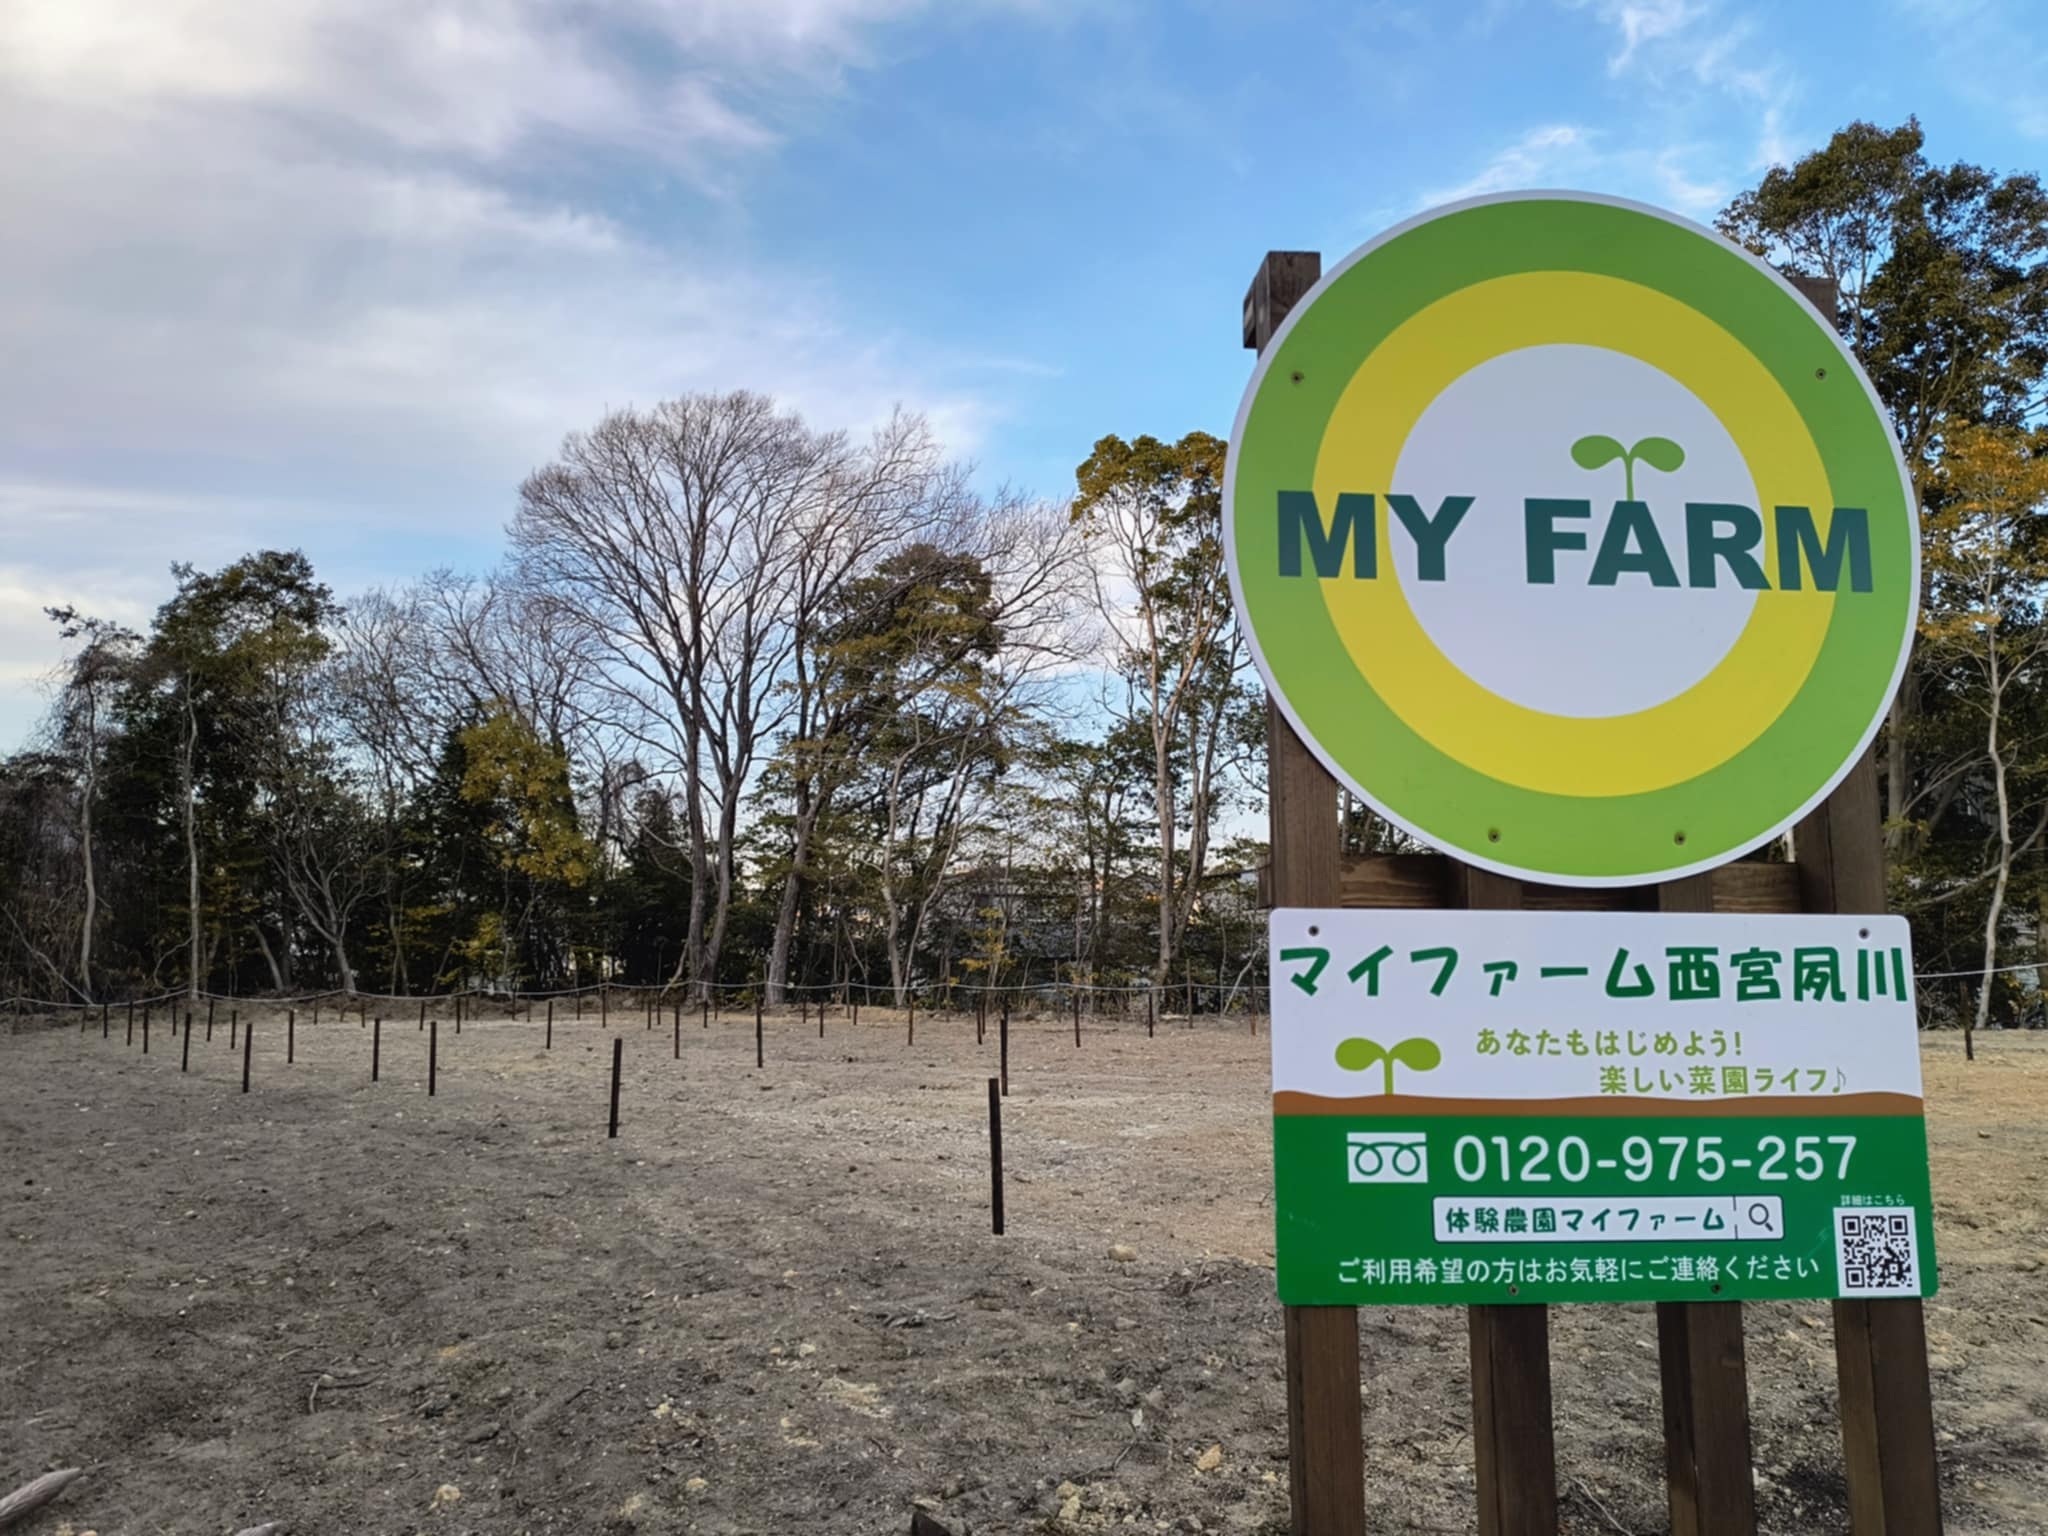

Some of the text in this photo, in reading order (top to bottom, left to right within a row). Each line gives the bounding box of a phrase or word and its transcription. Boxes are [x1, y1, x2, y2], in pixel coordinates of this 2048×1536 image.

[1276, 489, 1873, 593] MY FARM
[1279, 944, 1909, 1003] マイファーム西宮夙川
[1453, 1135, 1858, 1182] 0120-975-257
[1445, 1204, 1726, 1233] 体験農園マイファーム
[1338, 1254, 1820, 1285] ご利用希望の方はお気軽にご連絡ください
